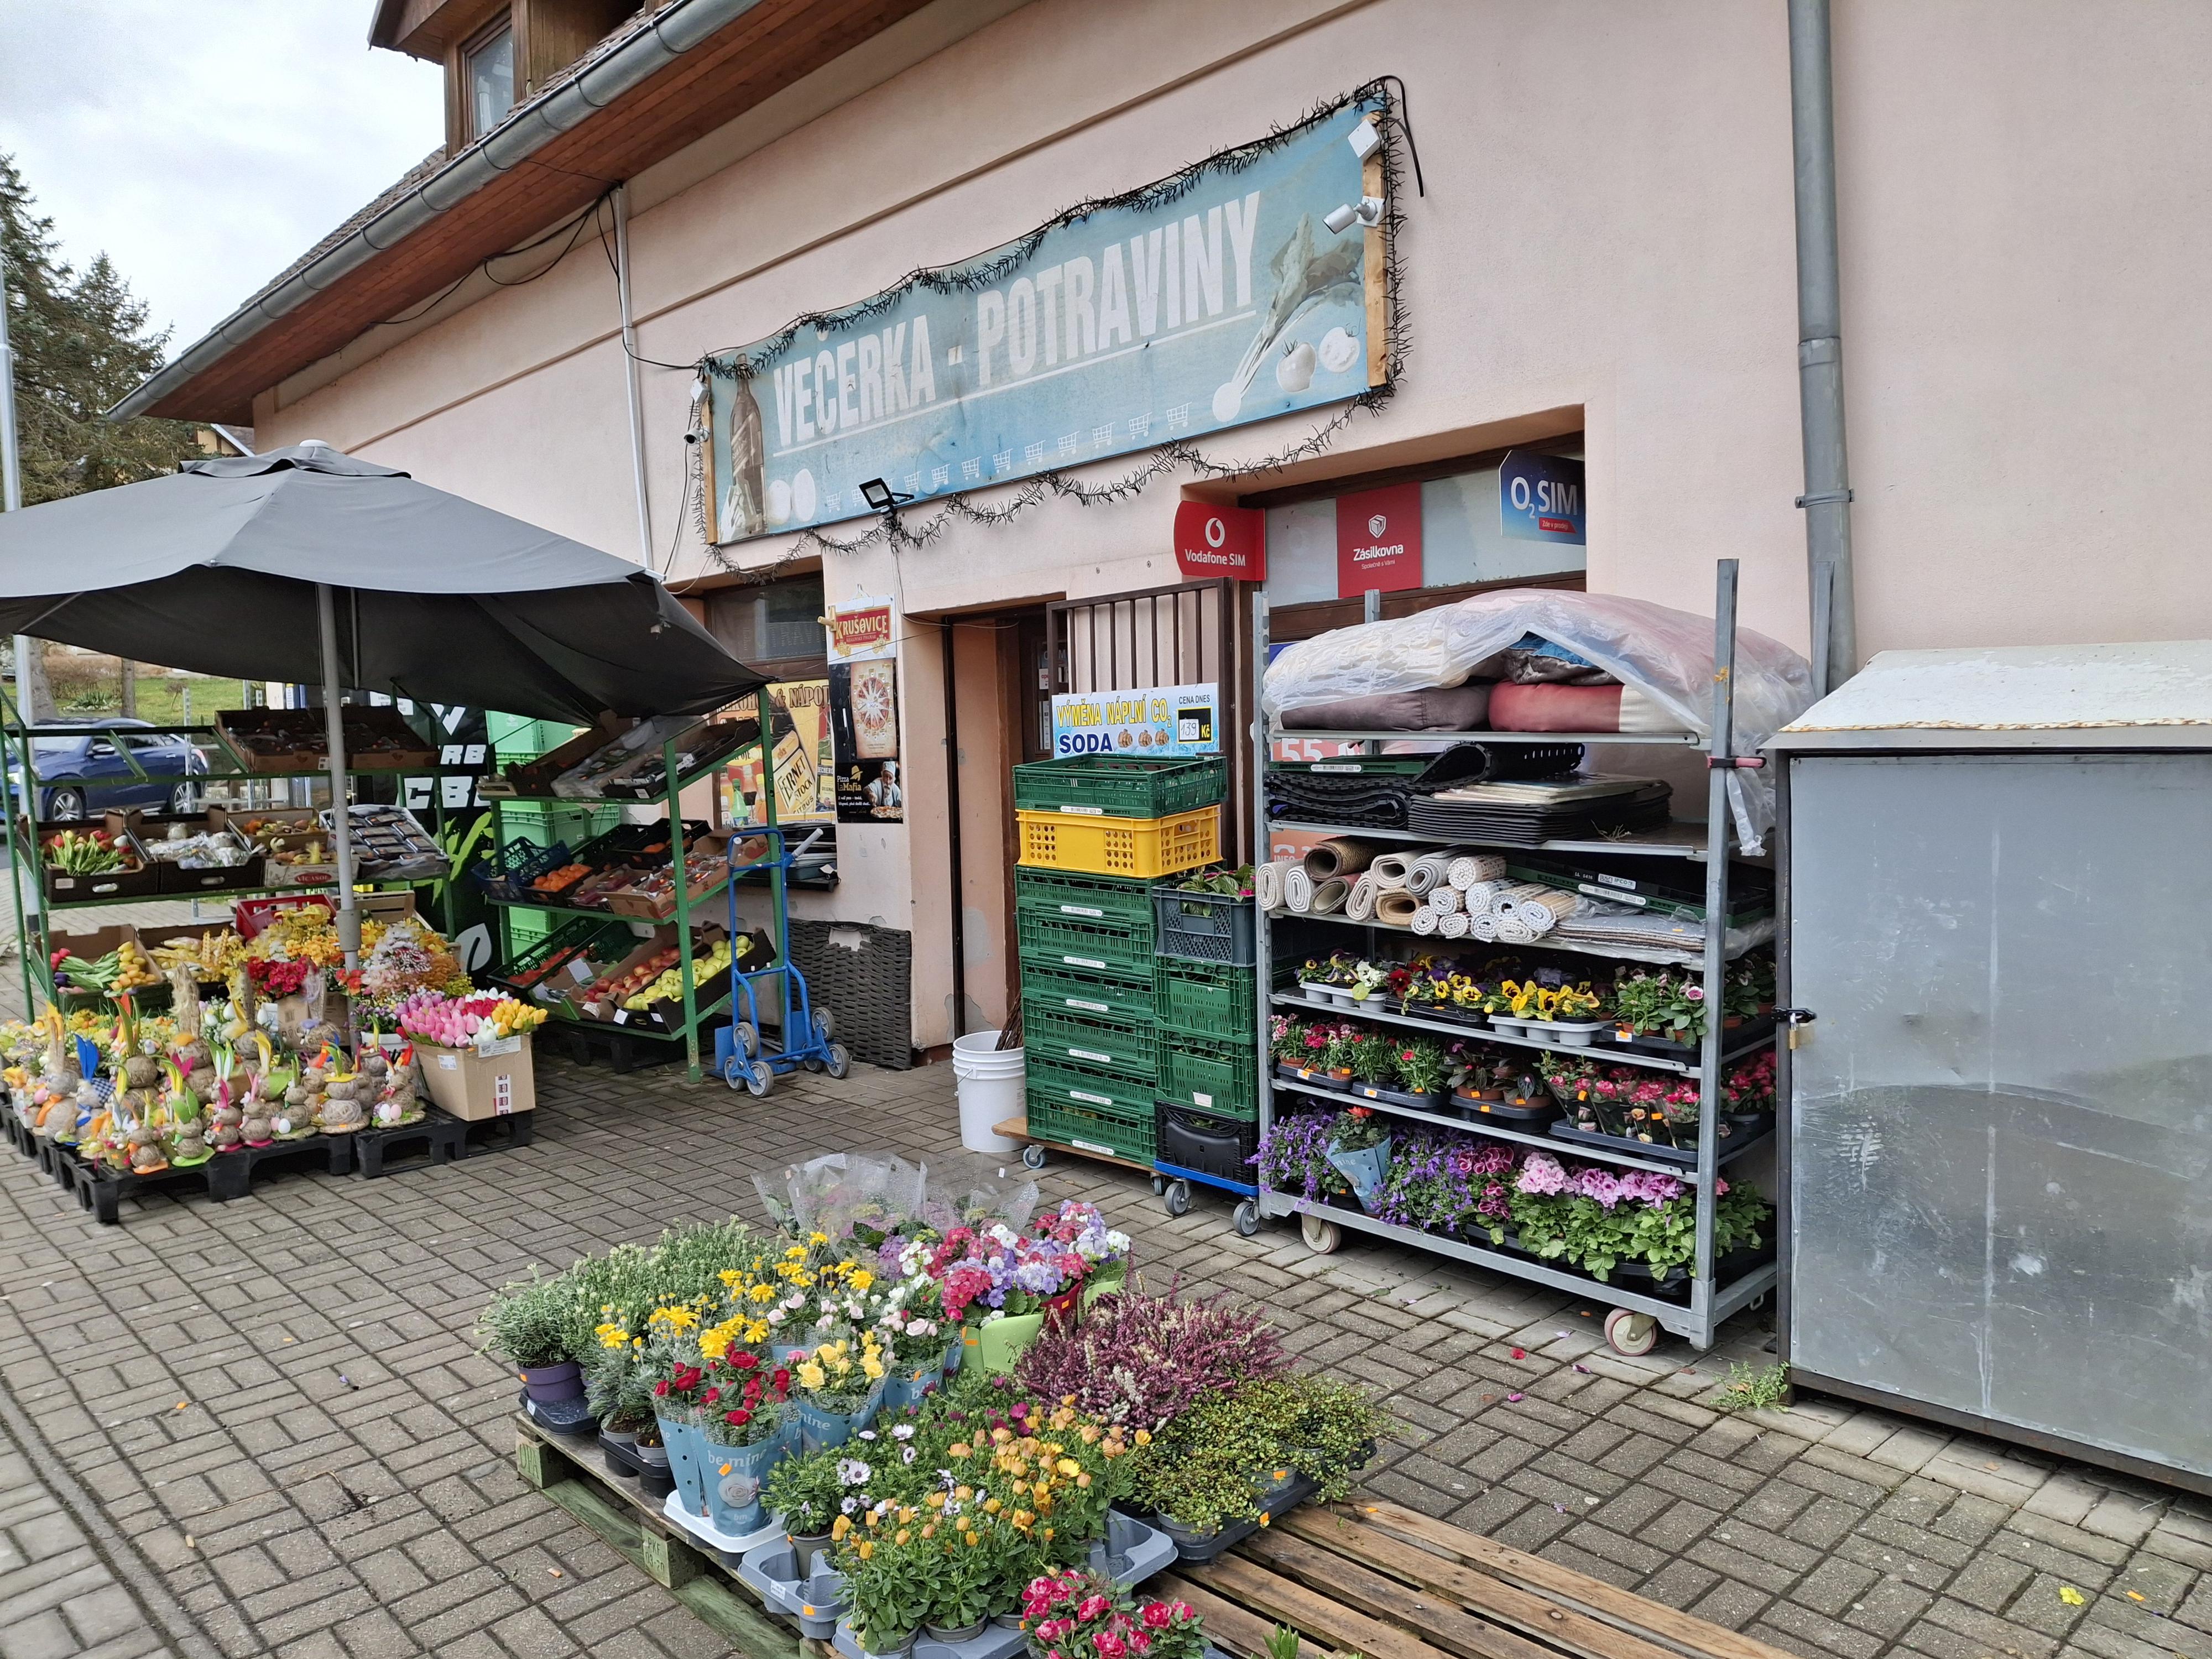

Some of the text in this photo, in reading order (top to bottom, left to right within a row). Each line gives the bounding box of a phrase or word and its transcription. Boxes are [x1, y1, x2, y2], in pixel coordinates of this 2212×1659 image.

[774, 315, 936, 446] VEČERKA
[977, 191, 1260, 386] POTRAVINY
[1537, 480, 1578, 515] SIM
[1554, 522, 1568, 530] prodeji
[1185, 549, 1246, 566] Vodafone SIM
[1353, 544, 1404, 561] Zásilkovna
[836, 614, 888, 639] KRUŠOVICE
[1057, 699, 1102, 727] VÝMĚNA
[1107, 693, 1146, 725] NÁPLNÍ
[1178, 694, 1211, 705] CENA DNES
[1181, 722, 1210, 738] 139 Kč
[1059, 733, 1113, 754] SODA
[776, 755, 806, 805] FERNET
[794, 776, 813, 799] STOCK
[707, 1449, 767, 1467] be mine
